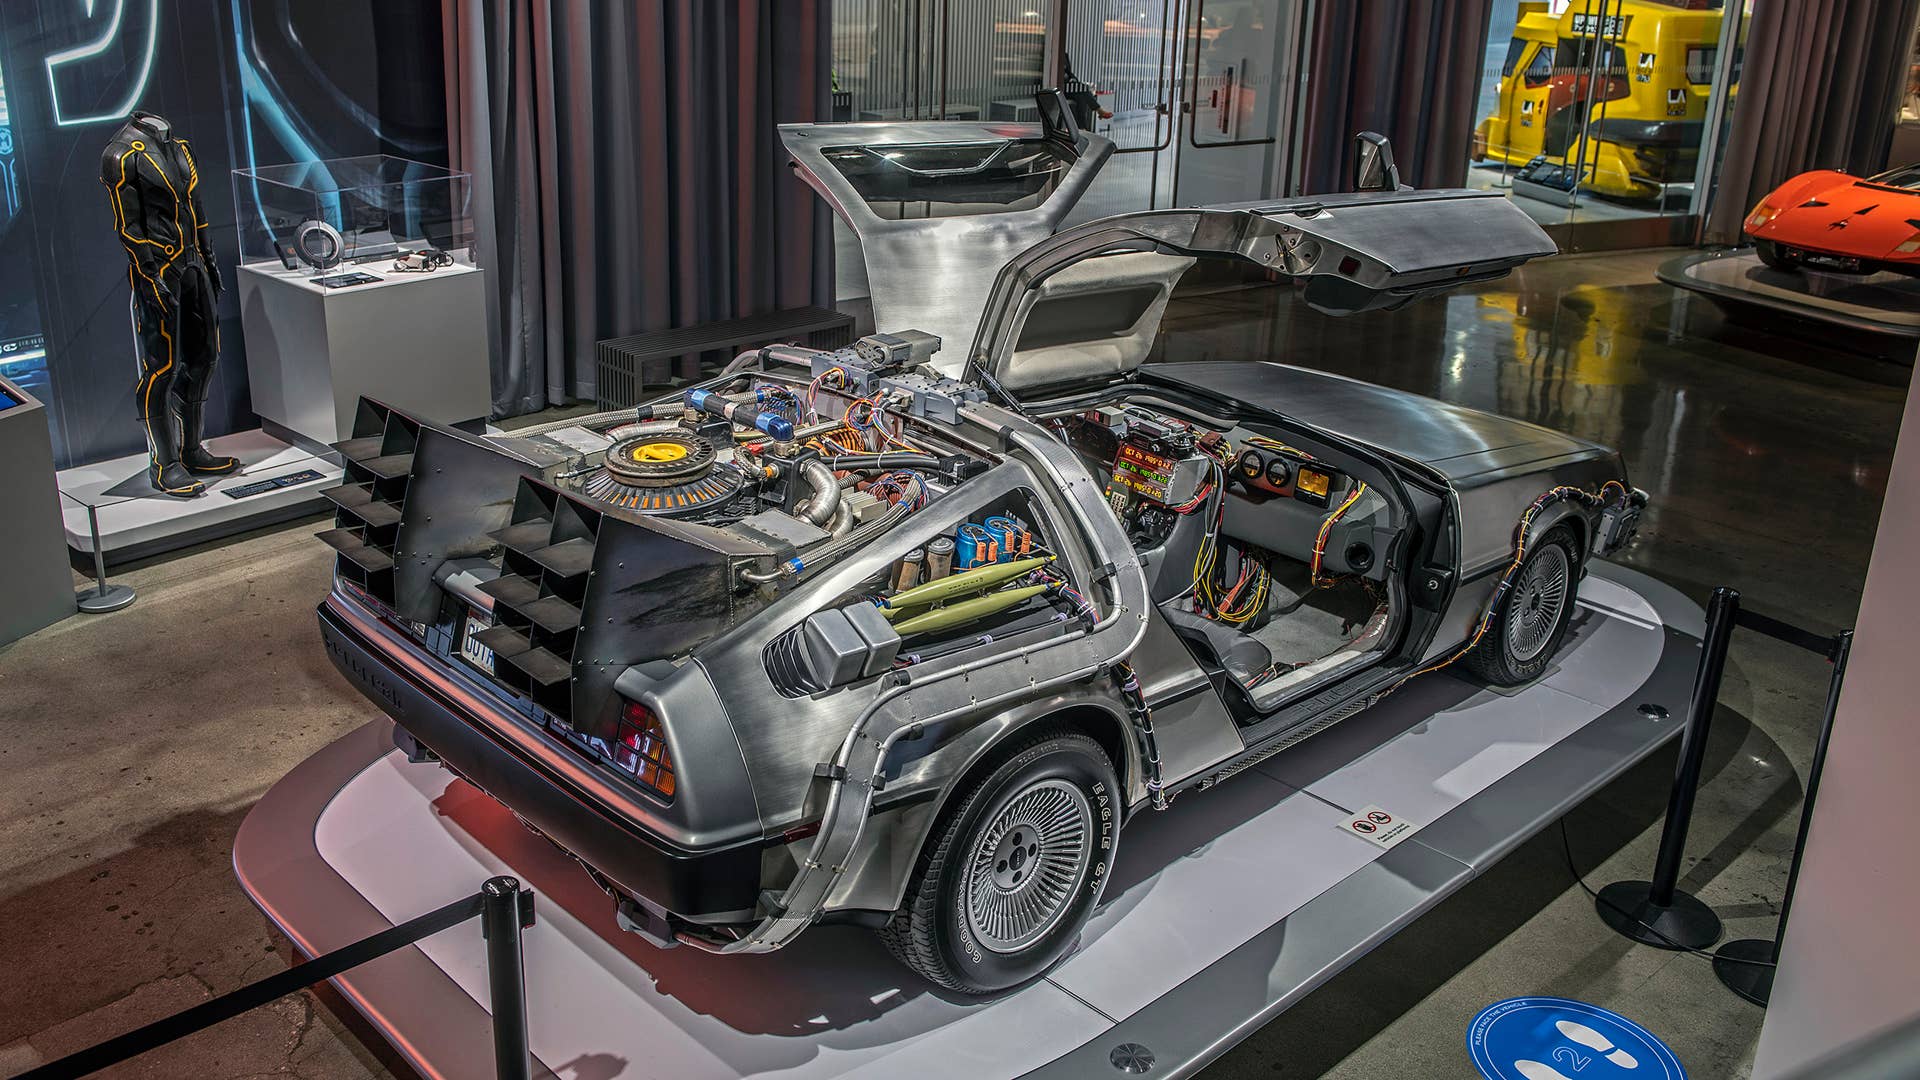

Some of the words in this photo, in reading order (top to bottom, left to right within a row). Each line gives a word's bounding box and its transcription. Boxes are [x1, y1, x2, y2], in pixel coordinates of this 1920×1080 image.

[1668, 89, 1686, 104] LA
[1092, 781, 1112, 850] EAGLE
[1090, 862, 1106, 895] GT
[1501, 1001, 1528, 1011] VEHICLE
[1552, 1046, 1592, 1072] 2
